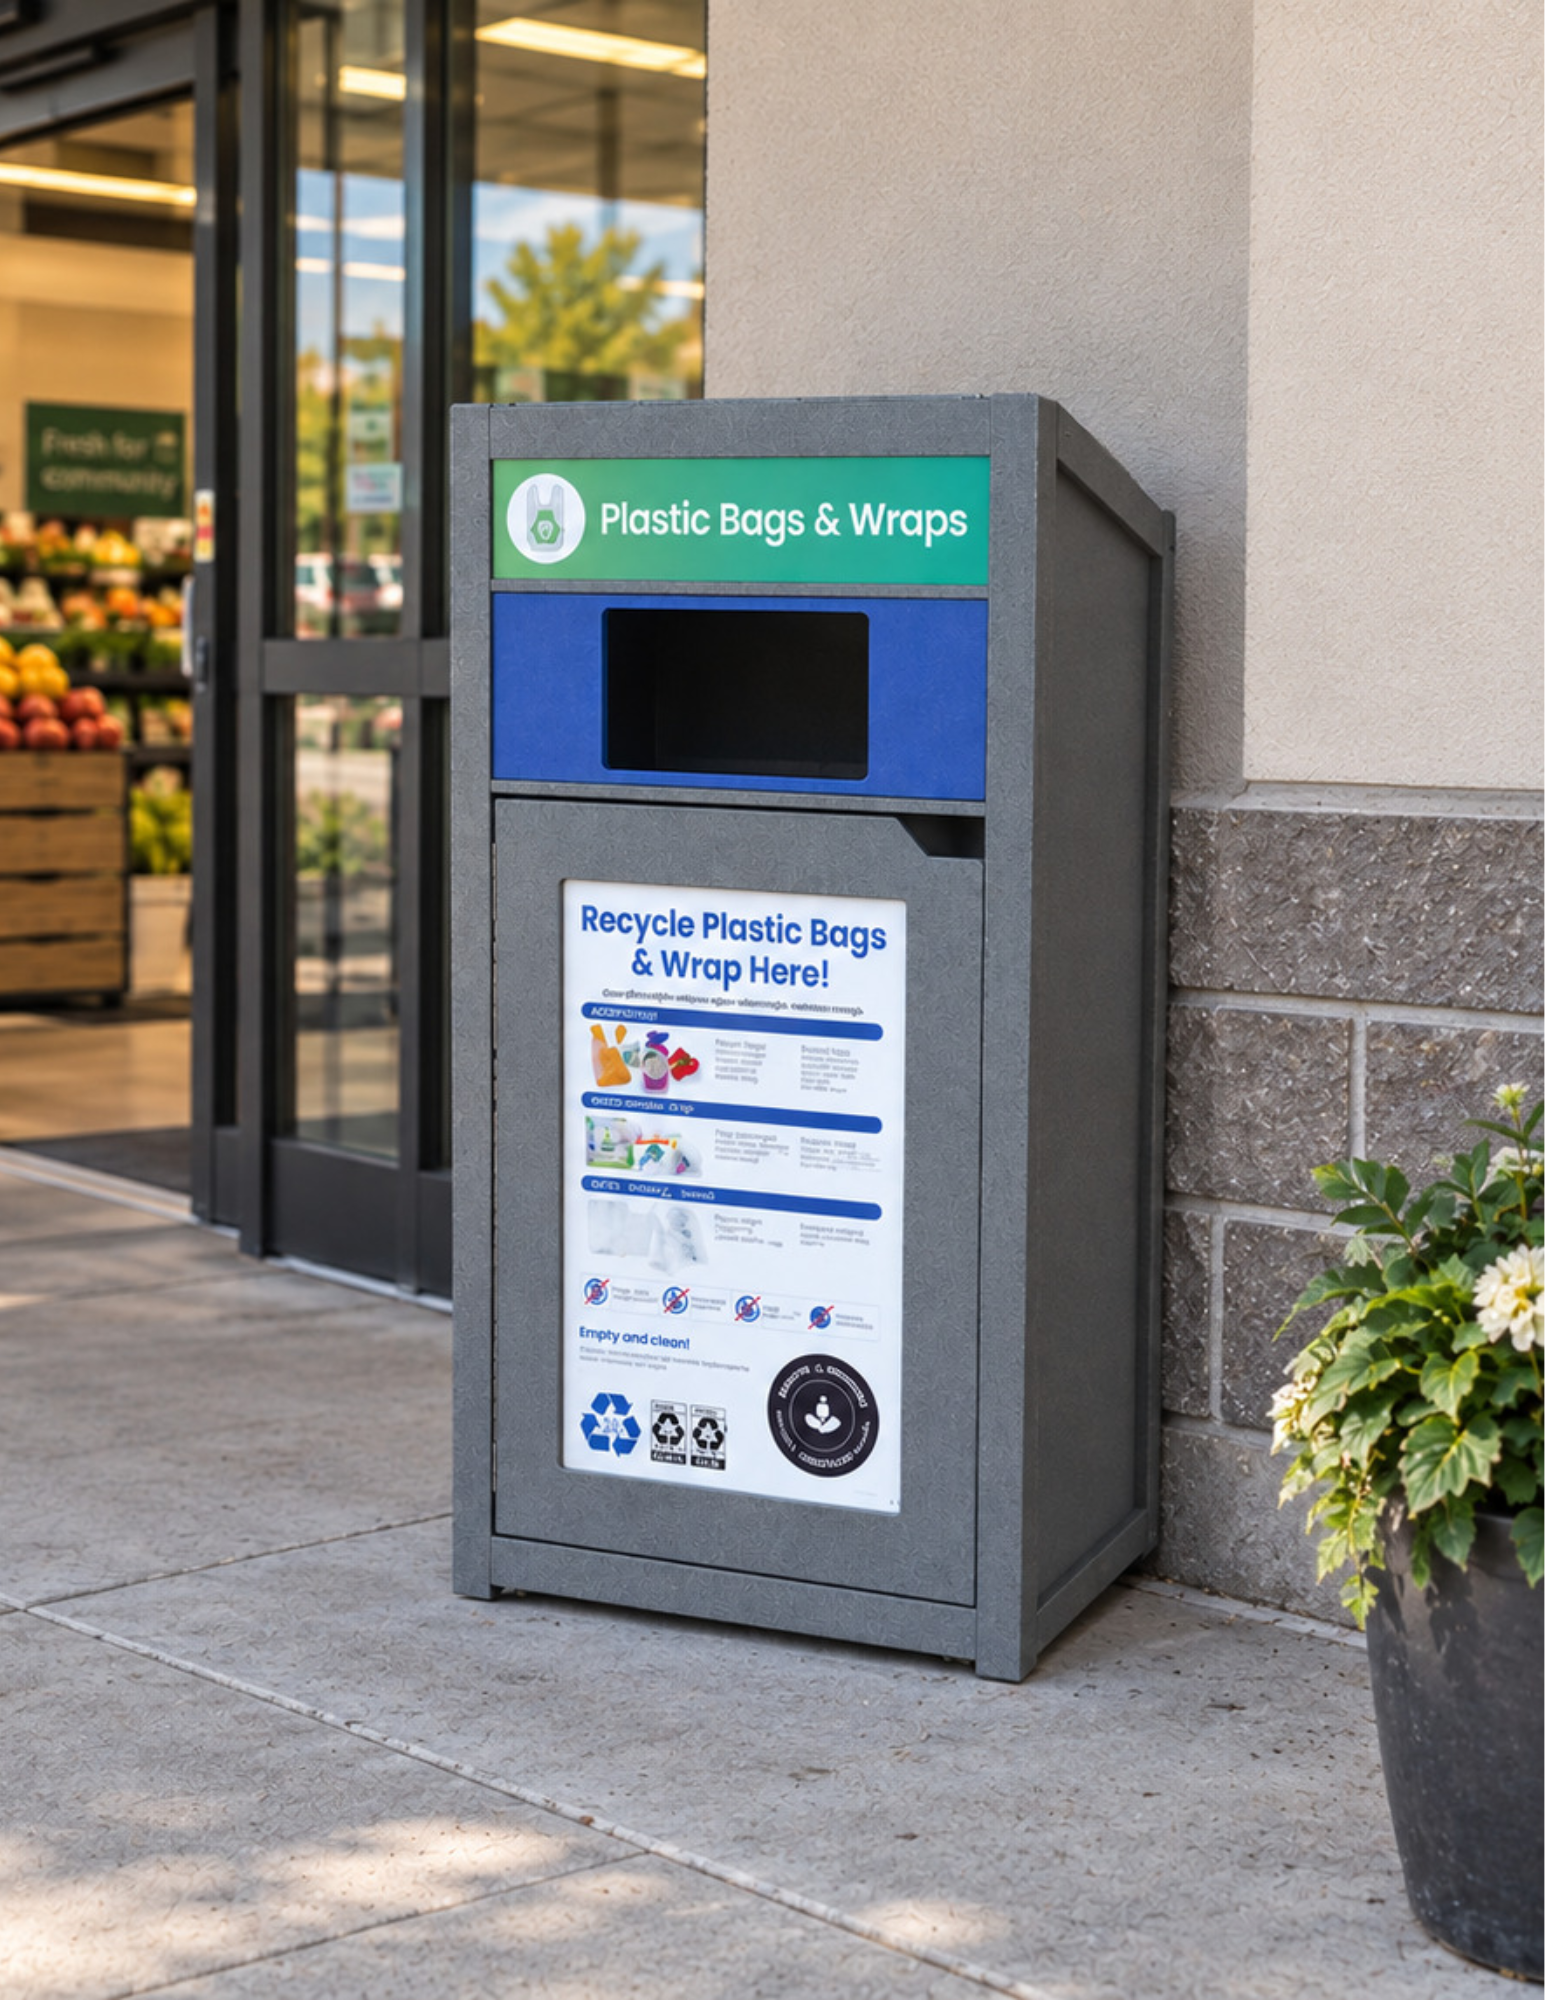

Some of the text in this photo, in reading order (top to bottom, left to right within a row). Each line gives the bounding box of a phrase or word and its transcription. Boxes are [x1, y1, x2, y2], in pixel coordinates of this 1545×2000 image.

[601, 500, 967, 547] Plastic Bags & Wraps
[581, 905, 887, 958] Recycle Plastic Bags
[631, 948, 829, 991] & Wrap Here!
[579, 1326, 690, 1350] Empty and clean!
